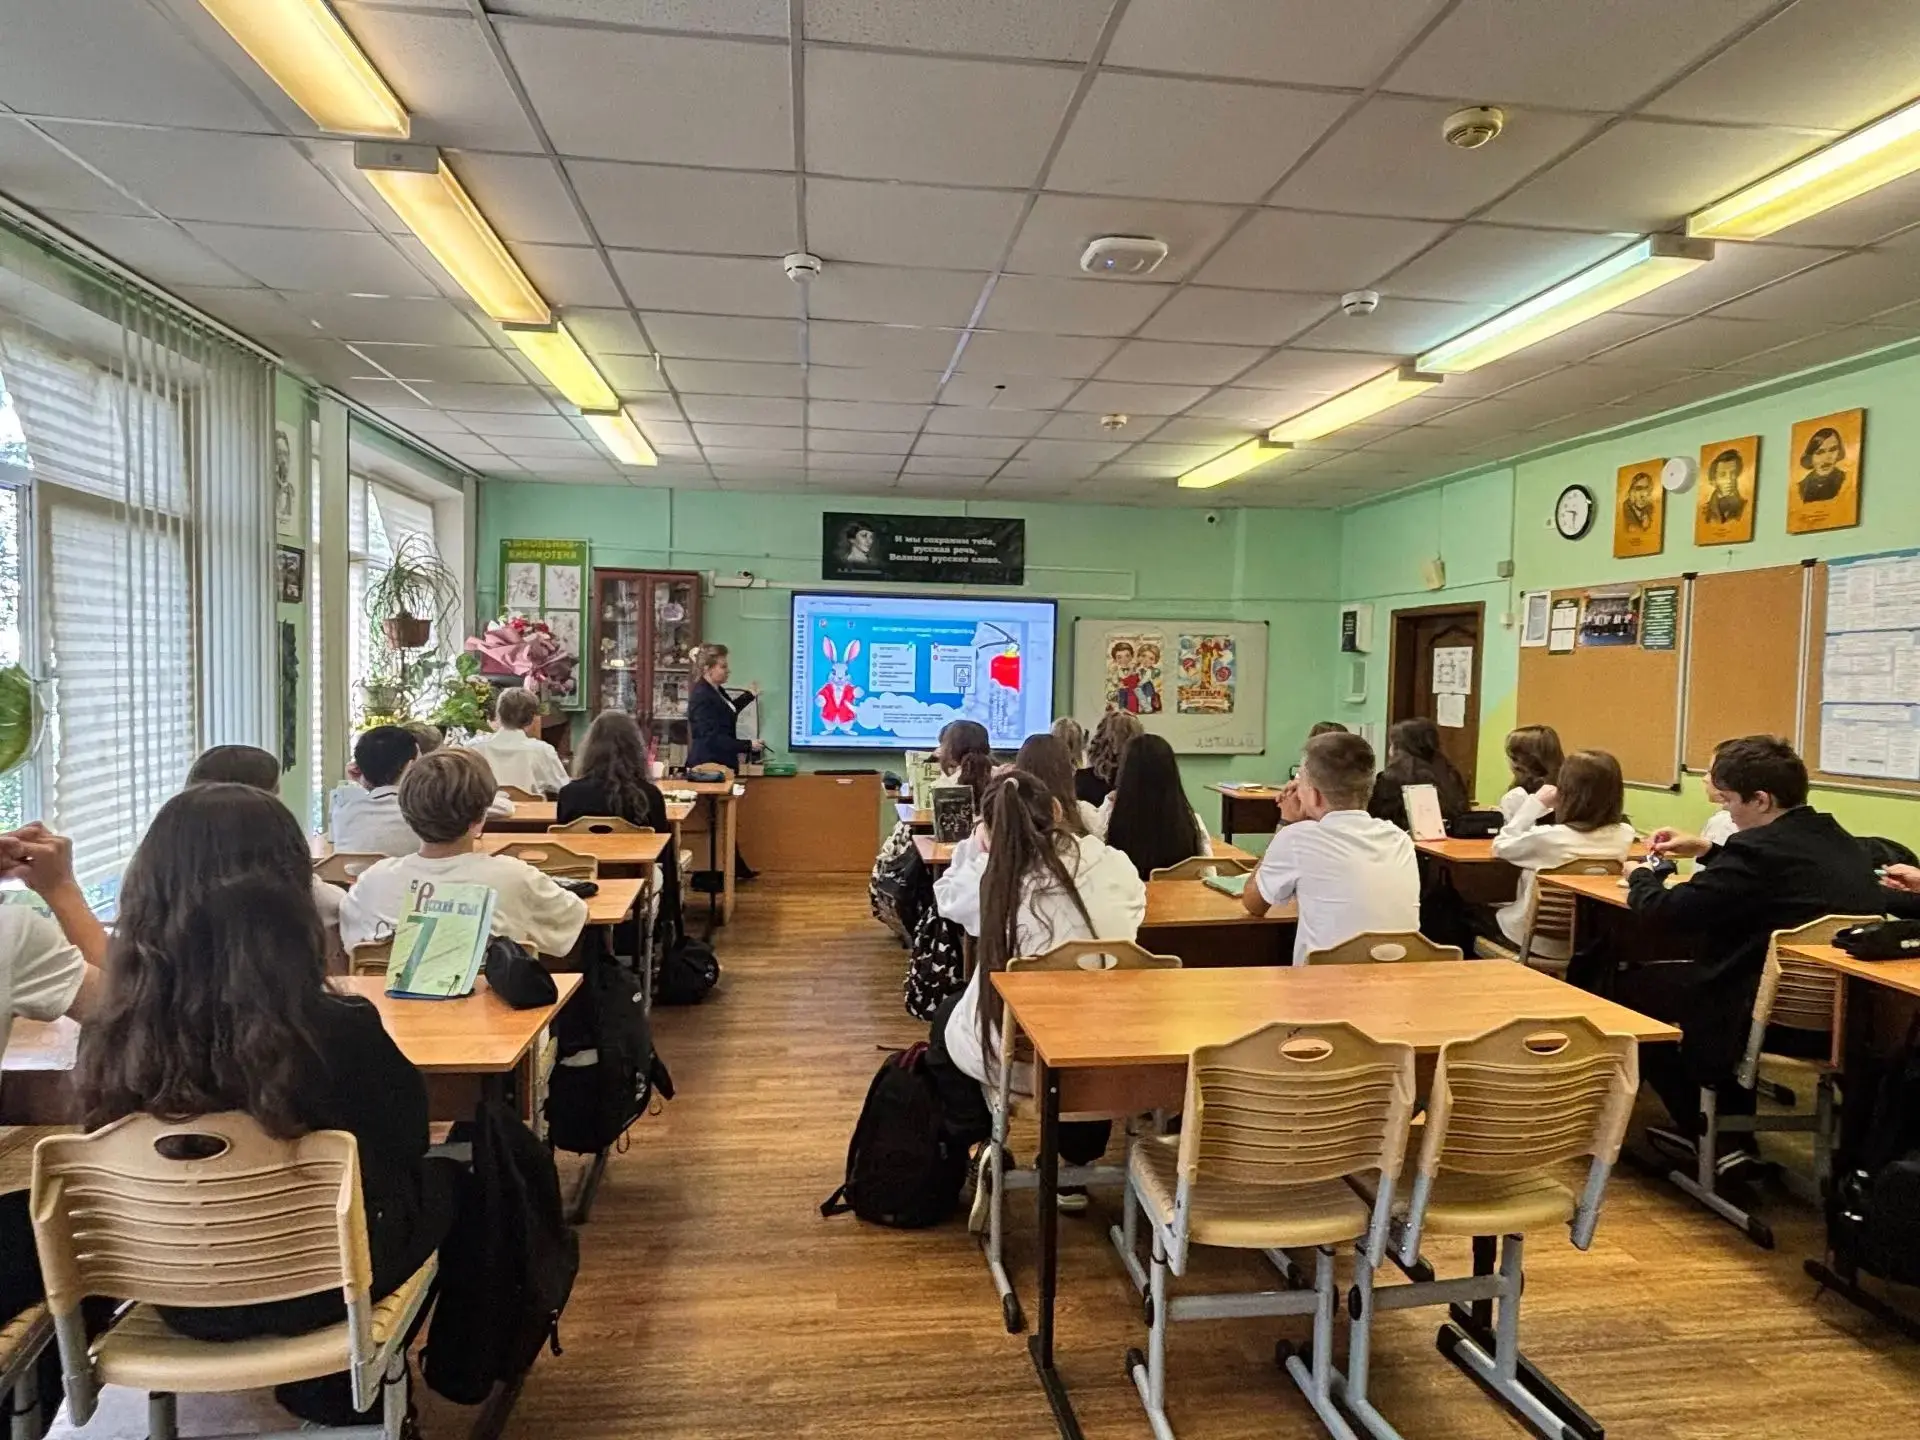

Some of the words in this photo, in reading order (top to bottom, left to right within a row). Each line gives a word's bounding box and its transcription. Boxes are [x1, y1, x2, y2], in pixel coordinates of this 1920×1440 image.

[894, 535, 903, 543] И
[923, 537, 970, 546] сохраним
[971, 537, 997, 546] тебя,
[508, 549, 577, 560] БИБЛИОТЕКА
[912, 546, 951, 555] русская
[952, 547, 978, 555] речь,
[889, 553, 930, 561] Великое
[931, 556, 969, 564] русское
[413, 882, 454, 915] Русский
[399, 915, 439, 992] 7
